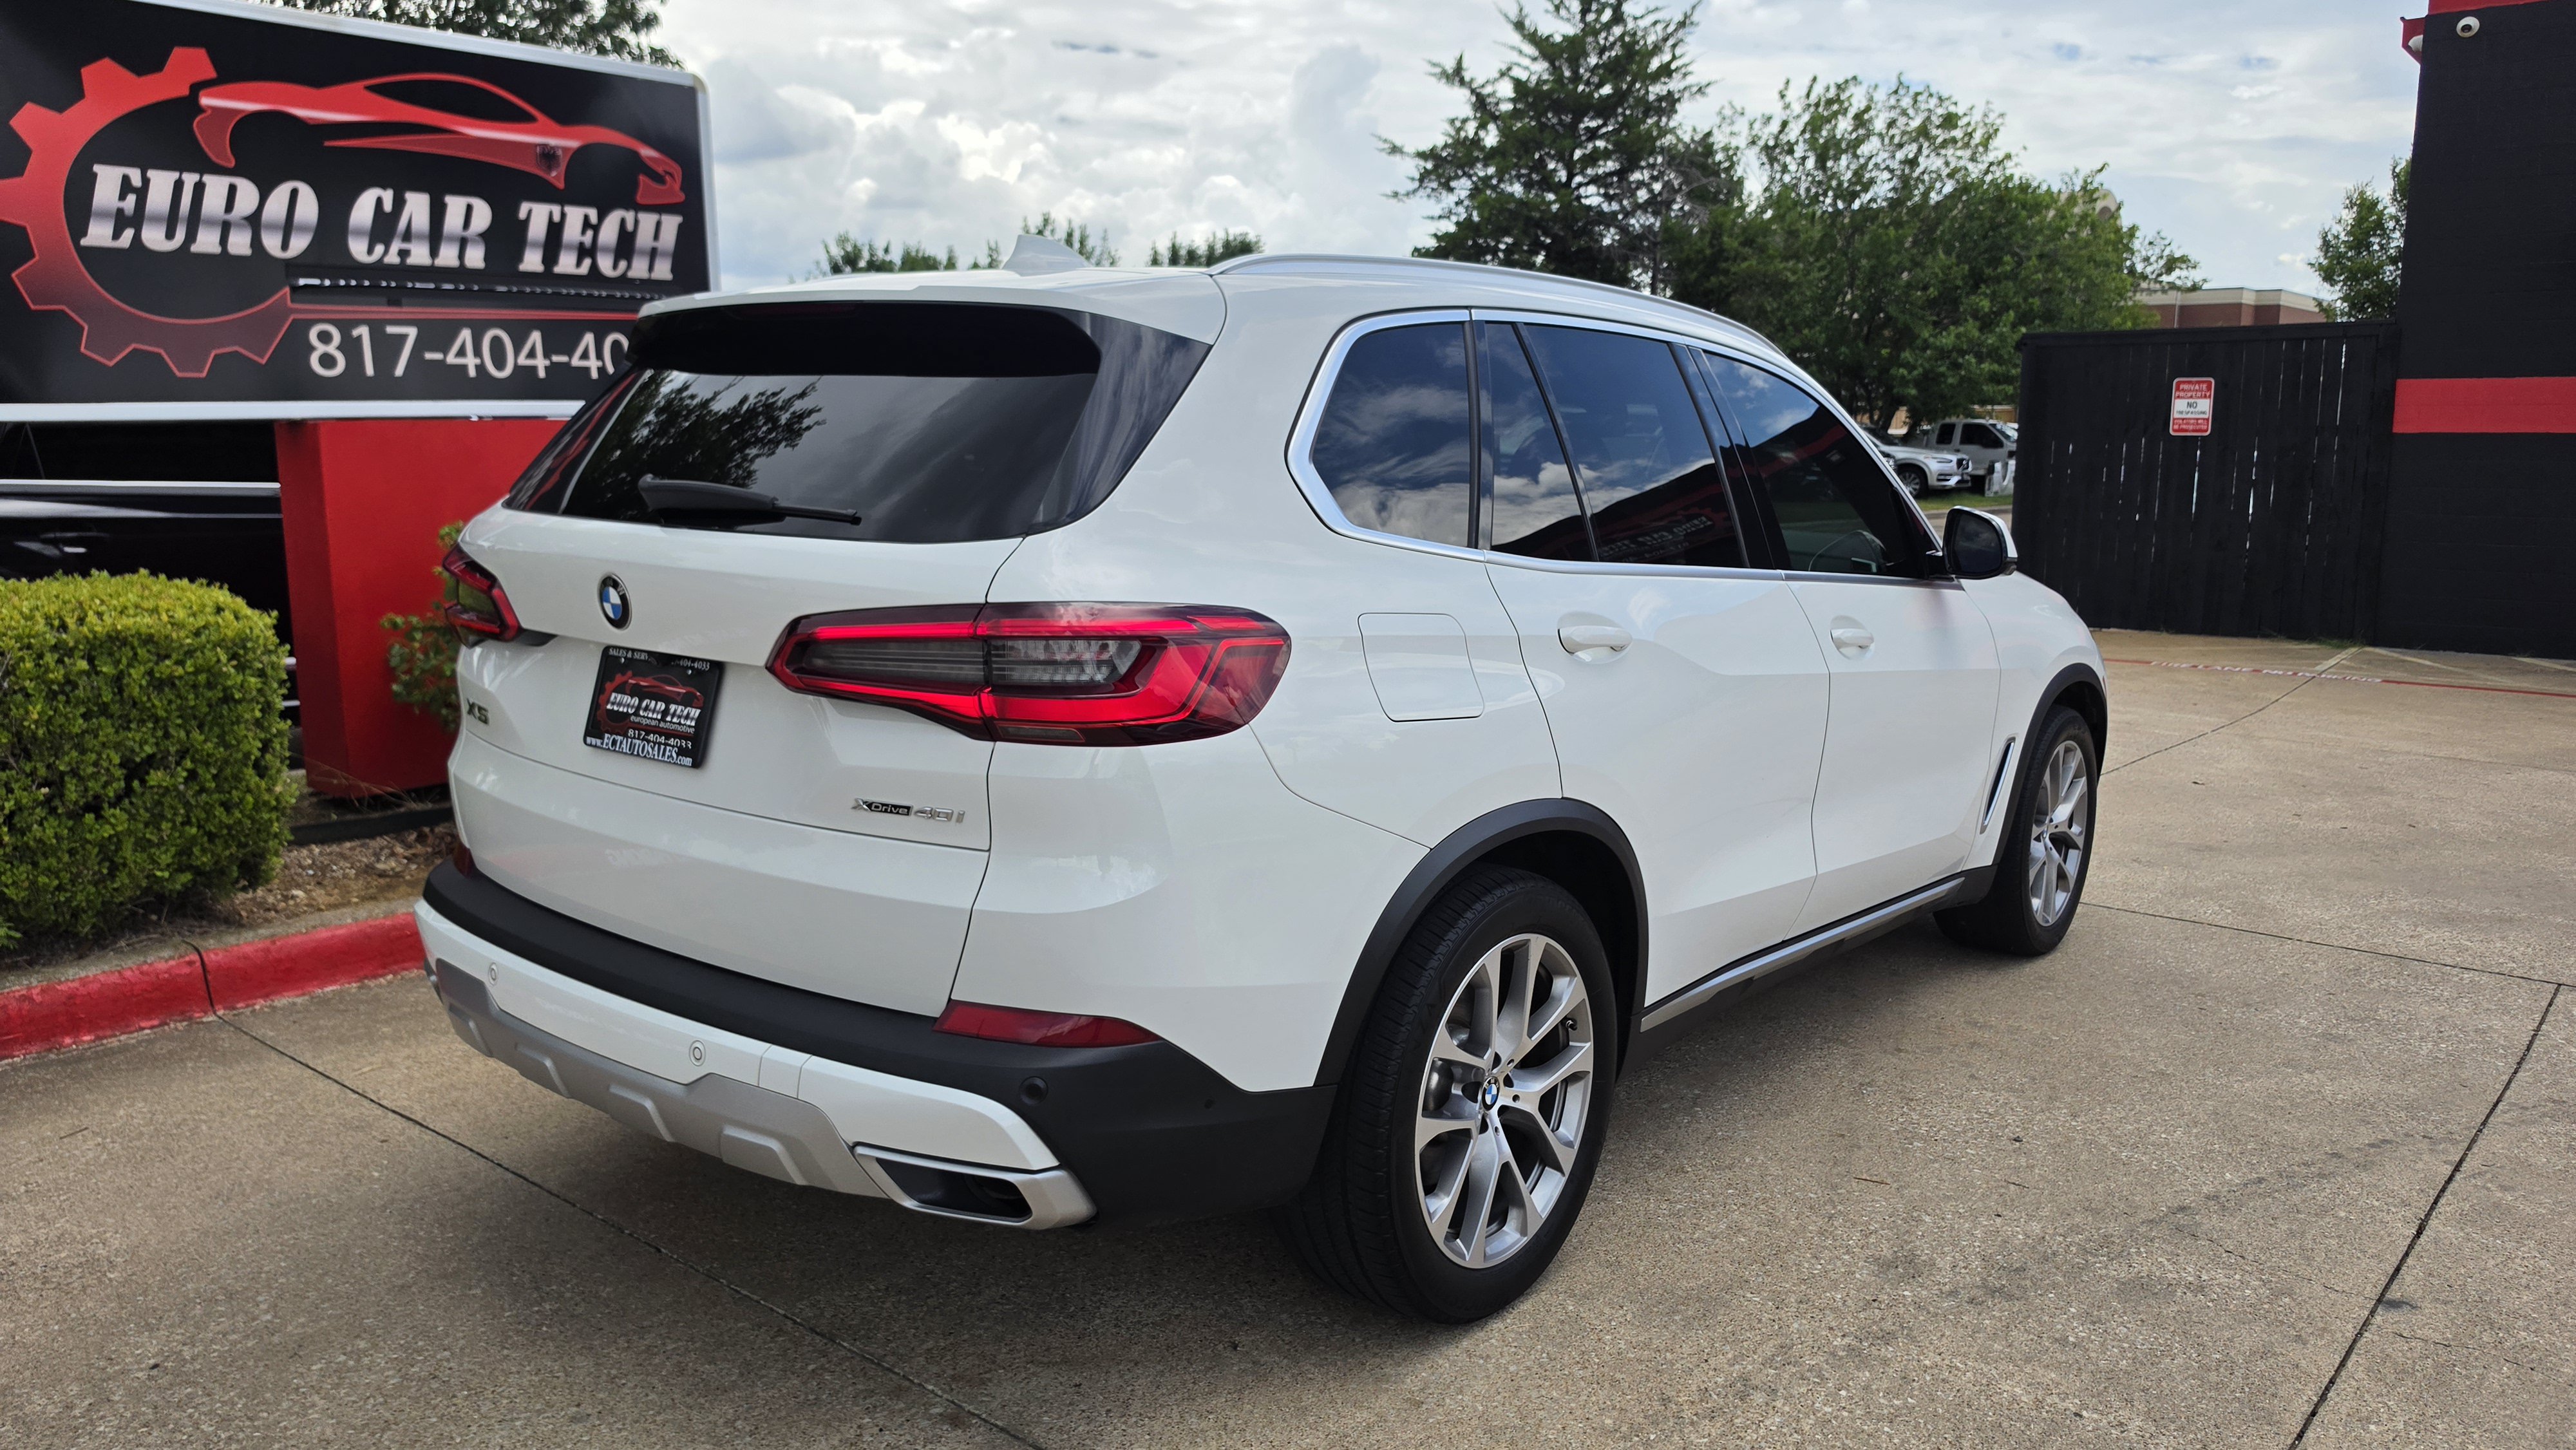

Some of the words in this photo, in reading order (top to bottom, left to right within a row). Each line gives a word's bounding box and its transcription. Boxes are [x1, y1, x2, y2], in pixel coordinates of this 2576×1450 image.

[80, 163, 319, 259] EURO
[347, 187, 494, 269] CAR
[517, 201, 684, 281] TECH
[2179, 383, 2208, 391] PRIVATE
[2186, 400, 2198, 409] NO
[608, 648, 627, 658] SALES
[634, 652, 650, 661] SERV
[466, 698, 489, 726] X5
[606, 692, 639, 714] EURO
[639, 698, 666, 719] CAR
[665, 703, 702, 726] TECH
[630, 715, 659, 726] european
[659, 719, 695, 735] automotive
[628, 729, 692, 749] 817-404-4033
[586, 733, 693, 767] www.ECTAUTOSALES.com
